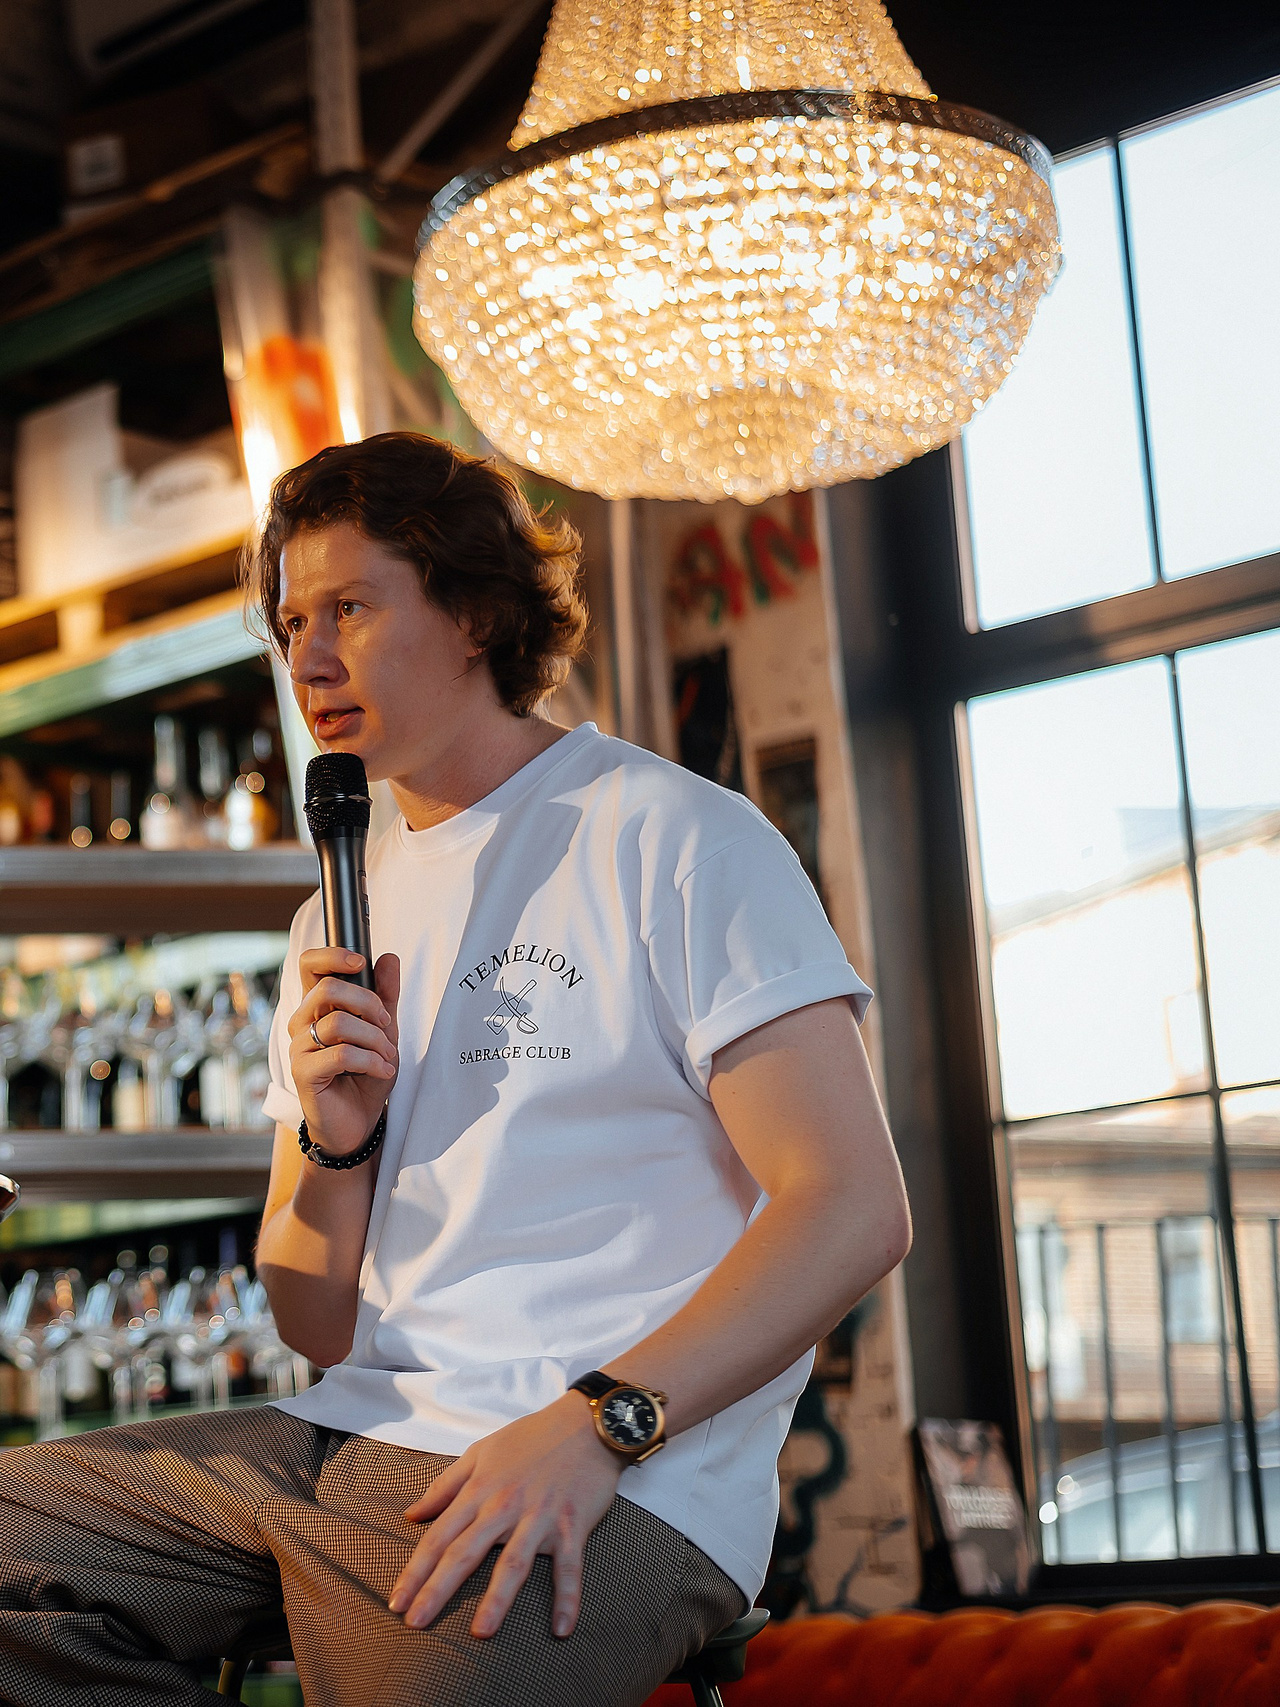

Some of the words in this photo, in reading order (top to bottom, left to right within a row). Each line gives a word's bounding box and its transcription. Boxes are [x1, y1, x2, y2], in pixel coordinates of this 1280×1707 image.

[458, 944, 584, 993] TEMELION
[459, 1046, 521, 1064] SABRAGE
[526, 1046, 572, 1060] CLUB
